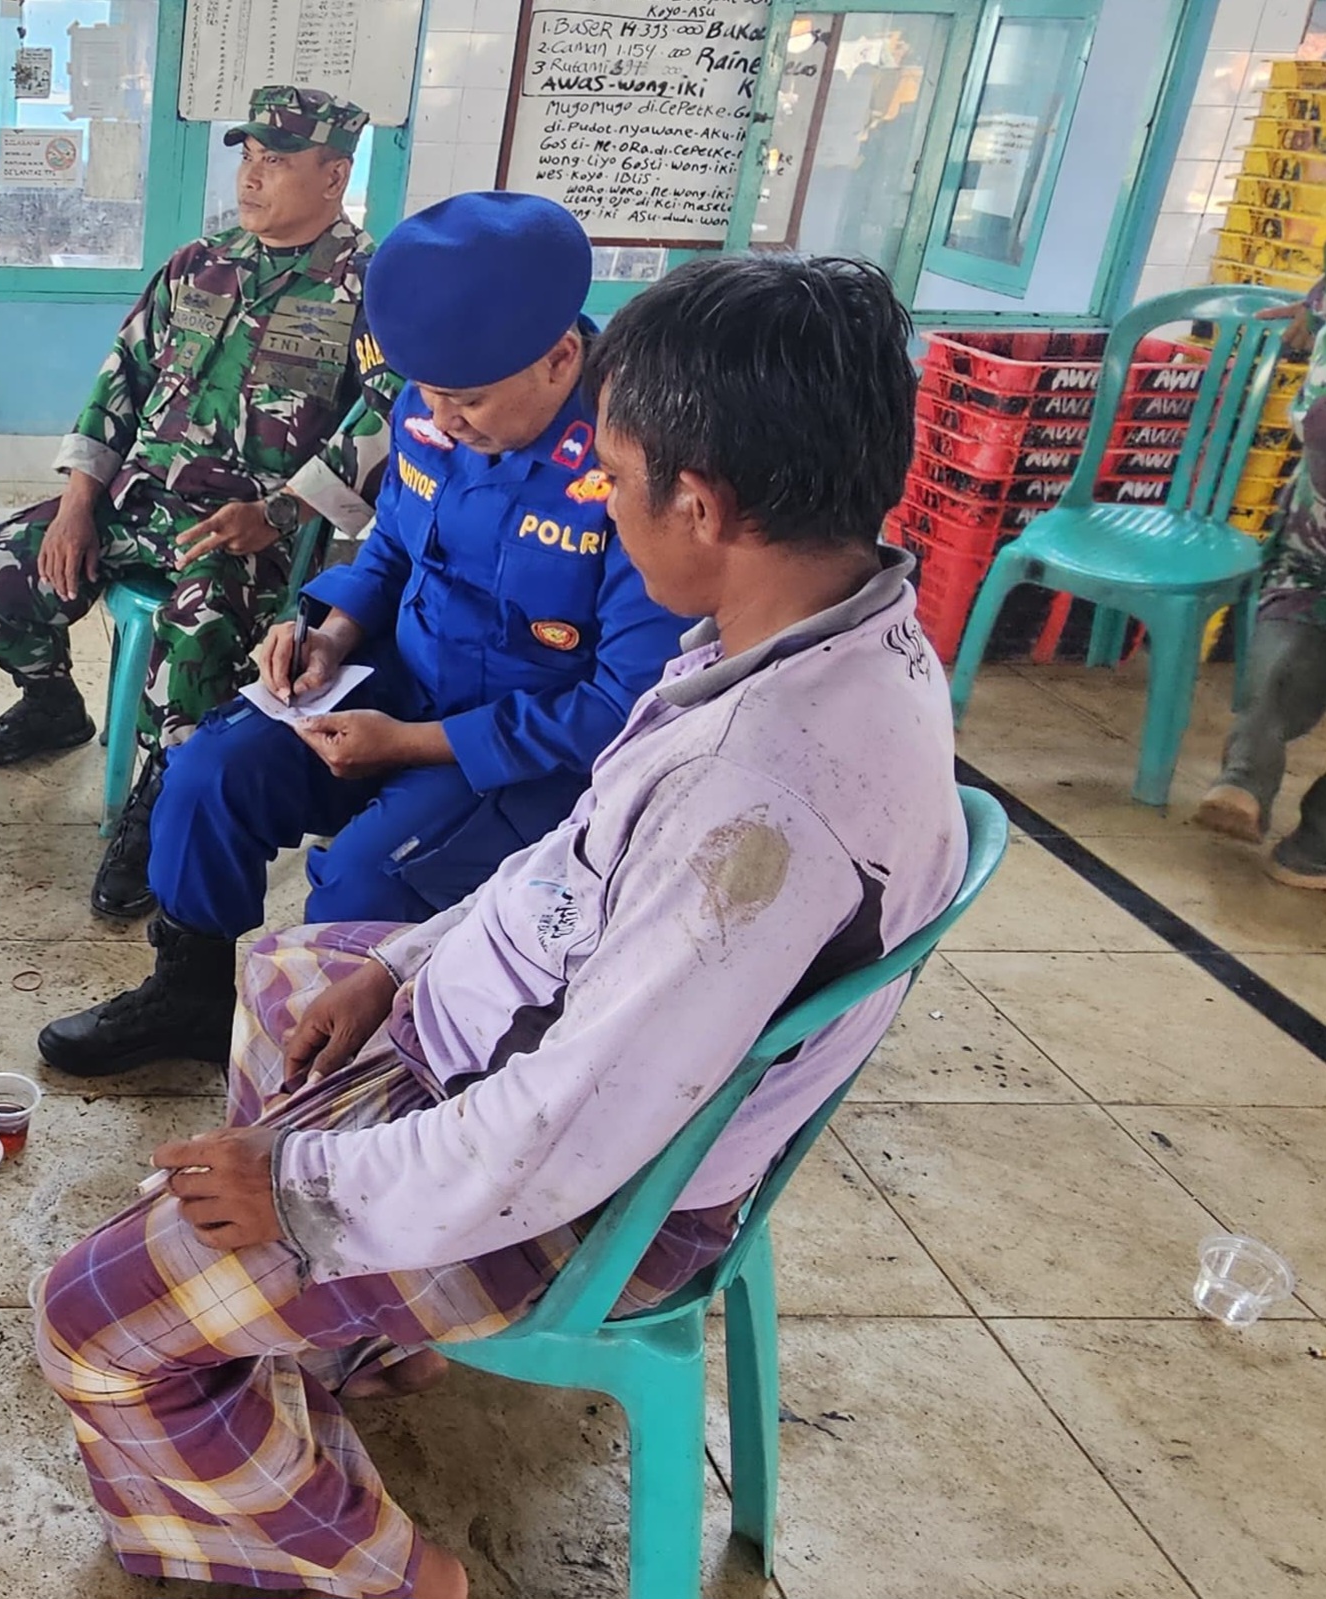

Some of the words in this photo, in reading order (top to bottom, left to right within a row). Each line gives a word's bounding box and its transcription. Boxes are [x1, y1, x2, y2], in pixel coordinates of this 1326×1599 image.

[269, 336, 300, 352] TNI
[314, 344, 340, 361] AL
[1153, 368, 1200, 392] AWI
[1045, 397, 1090, 415] AWI
[1146, 397, 1189, 415] AWI
[1116, 480, 1164, 502] AWI
